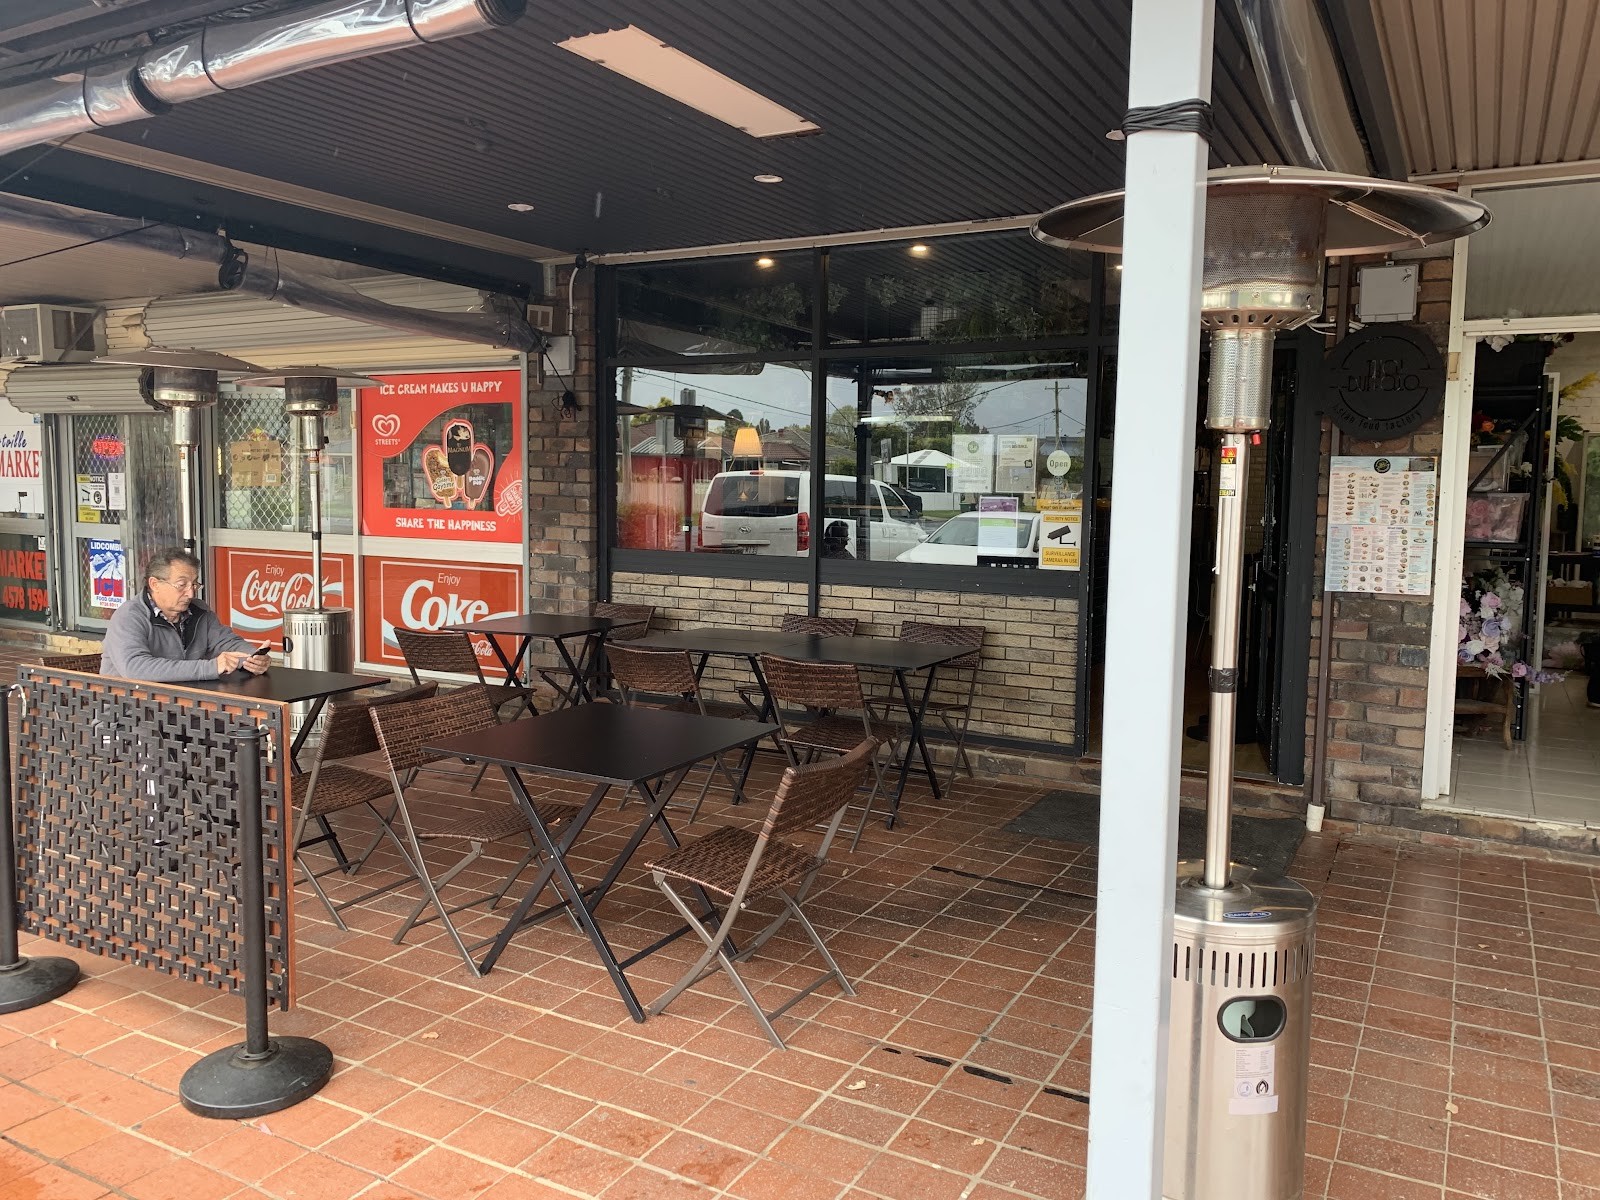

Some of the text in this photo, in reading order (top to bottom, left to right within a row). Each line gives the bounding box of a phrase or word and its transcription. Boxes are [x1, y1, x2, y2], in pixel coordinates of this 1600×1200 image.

[380, 381, 502, 395] ICE CREAM MAKES U HAPPY
[0, 431, 27, 448] tville
[1050, 459, 1068, 468] Open
[395, 517, 497, 532] SHARE THE HAPPINESS
[266, 564, 285, 576] Enjoy
[438, 573, 461, 586] Enjoy
[94, 578, 124, 597] ICE
[401, 579, 489, 631] Coke
